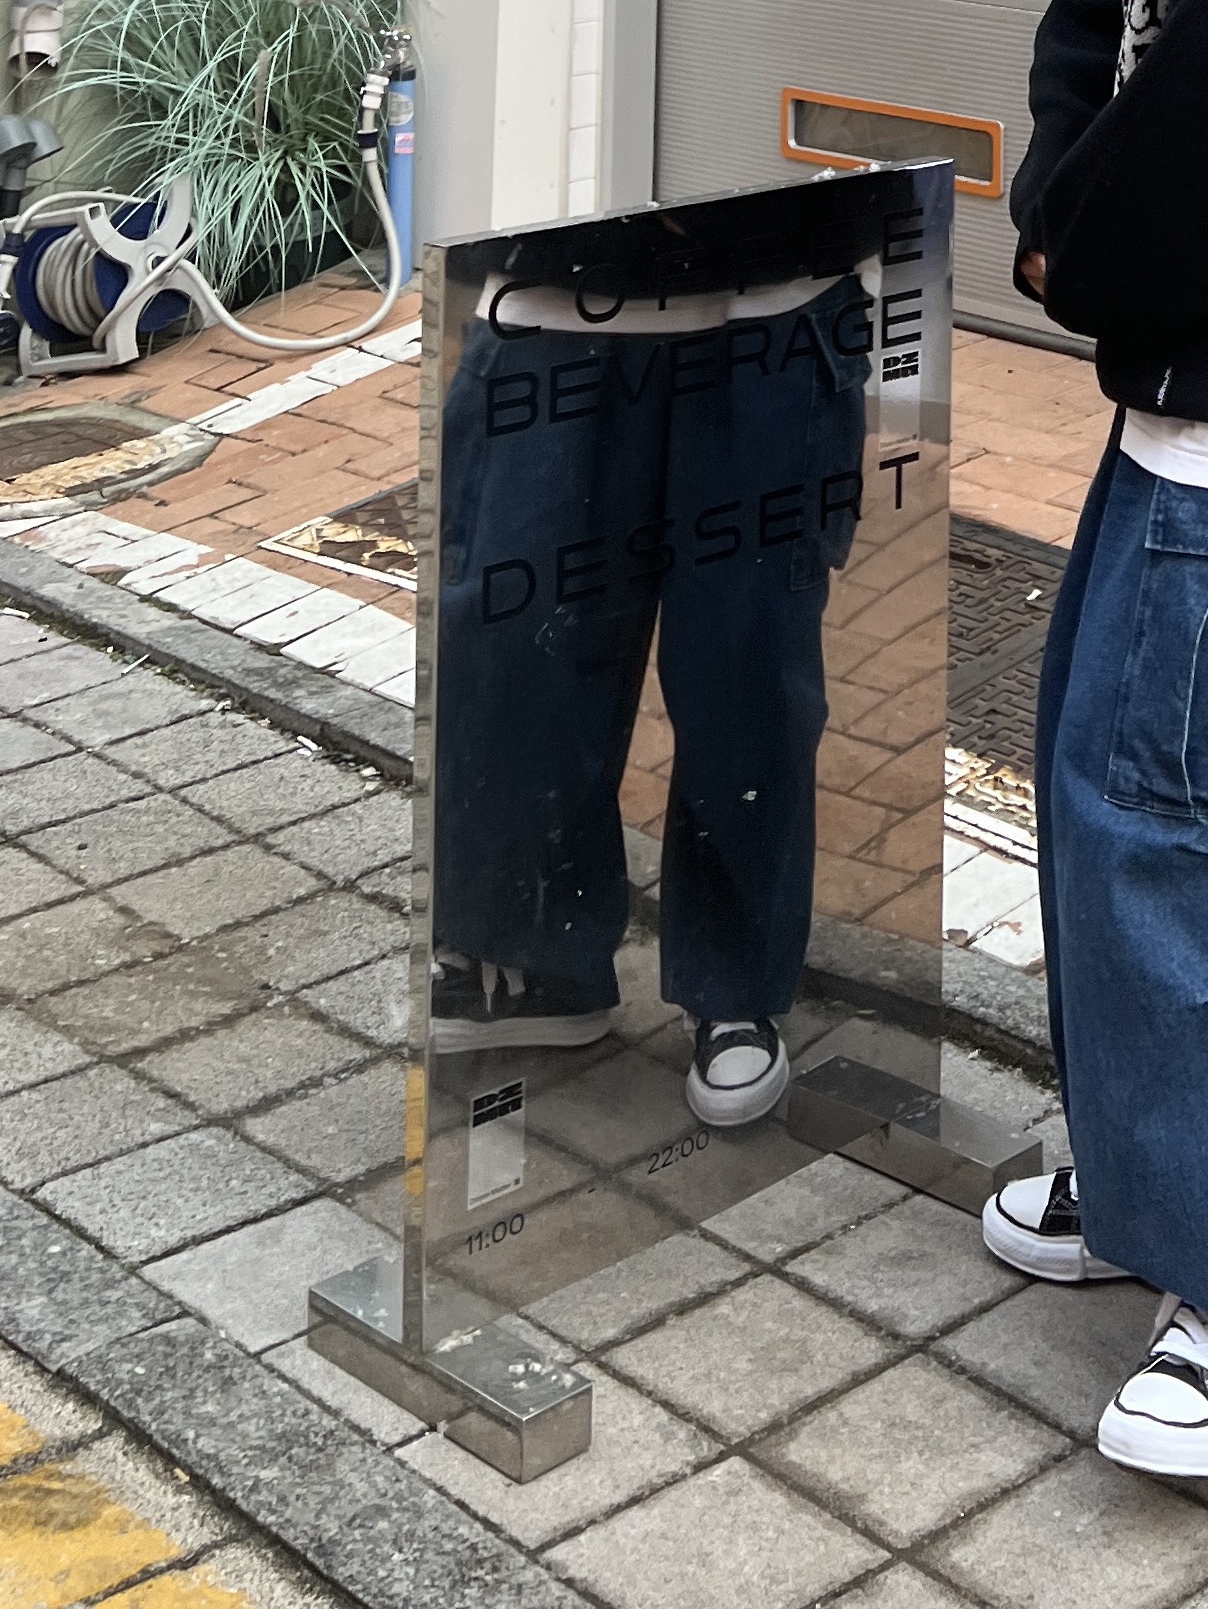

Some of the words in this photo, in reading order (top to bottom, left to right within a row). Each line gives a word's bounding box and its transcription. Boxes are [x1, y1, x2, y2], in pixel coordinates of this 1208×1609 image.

[485, 288, 923, 438] BEVERAGE
[481, 451, 920, 625] DESSERT
[647, 1129, 711, 1175] 22:00
[464, 1213, 525, 1256] 11:00
